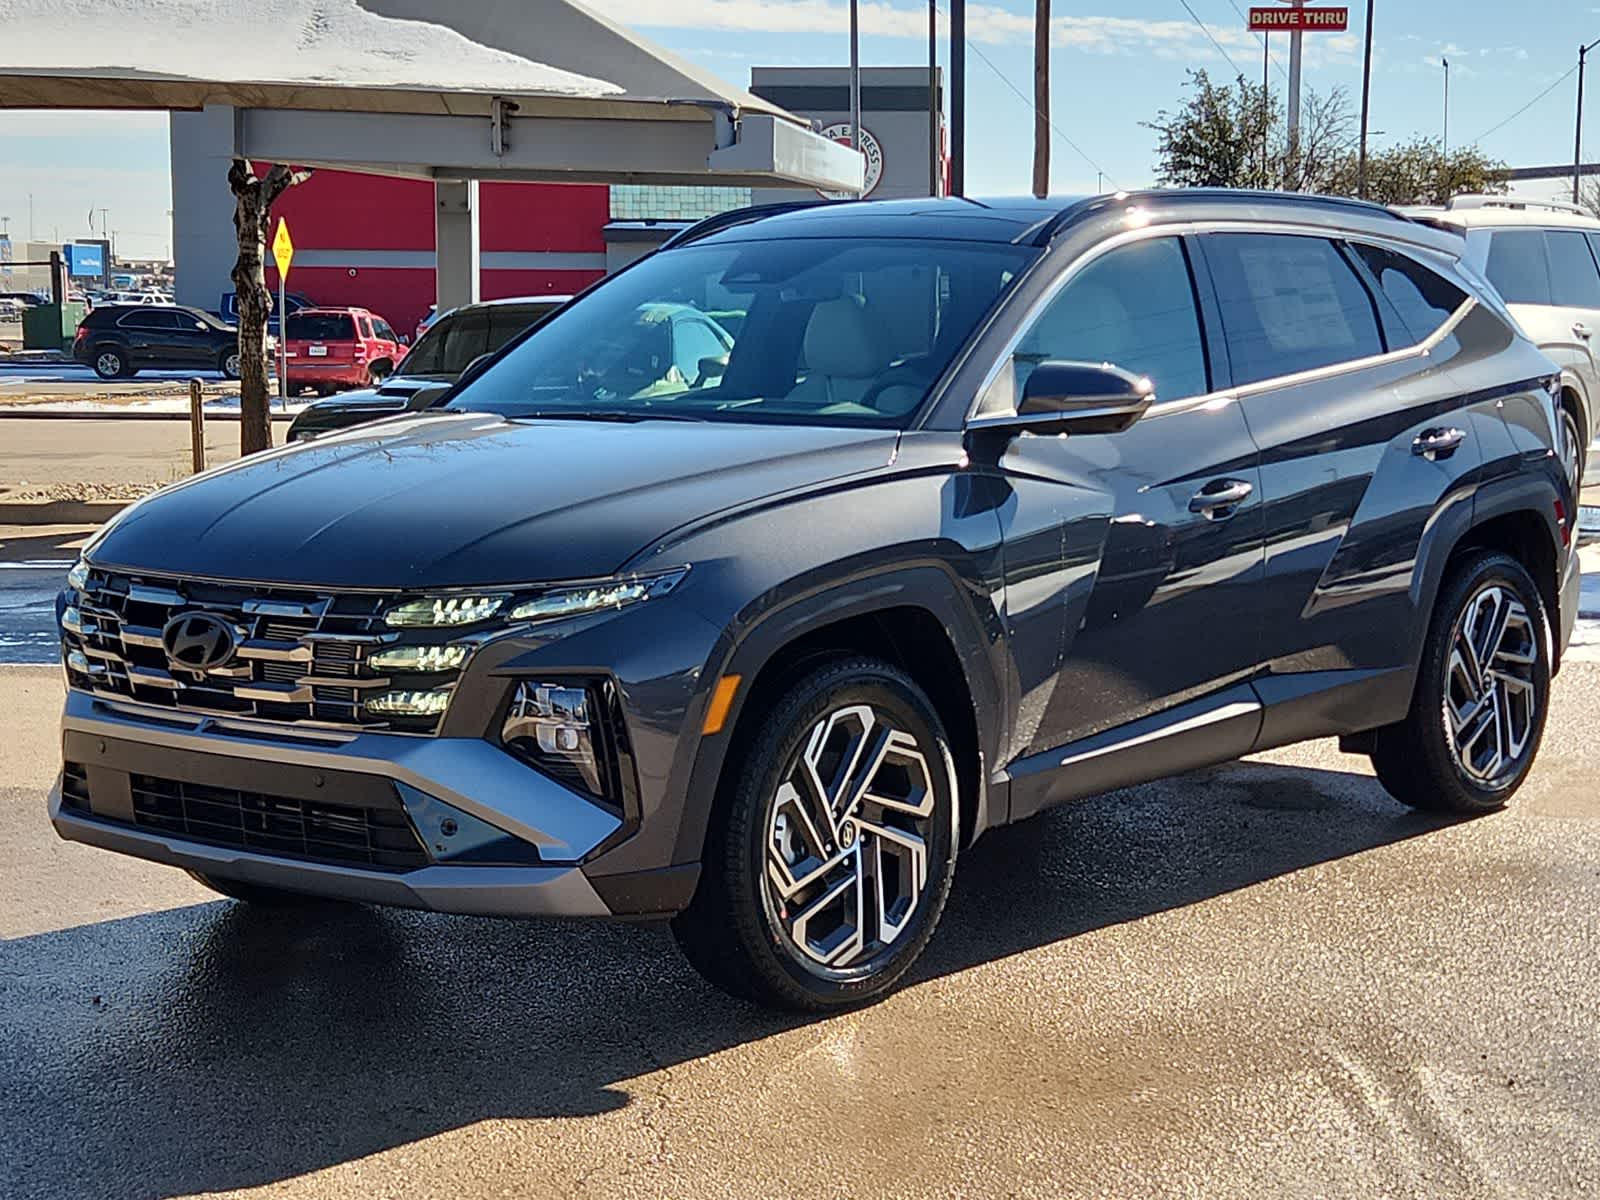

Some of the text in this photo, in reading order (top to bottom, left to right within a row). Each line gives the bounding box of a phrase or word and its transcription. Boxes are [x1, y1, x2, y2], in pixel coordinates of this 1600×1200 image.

[1252, 12, 1346, 24] DRIVE THRU
[841, 126, 880, 164] EPRESS
